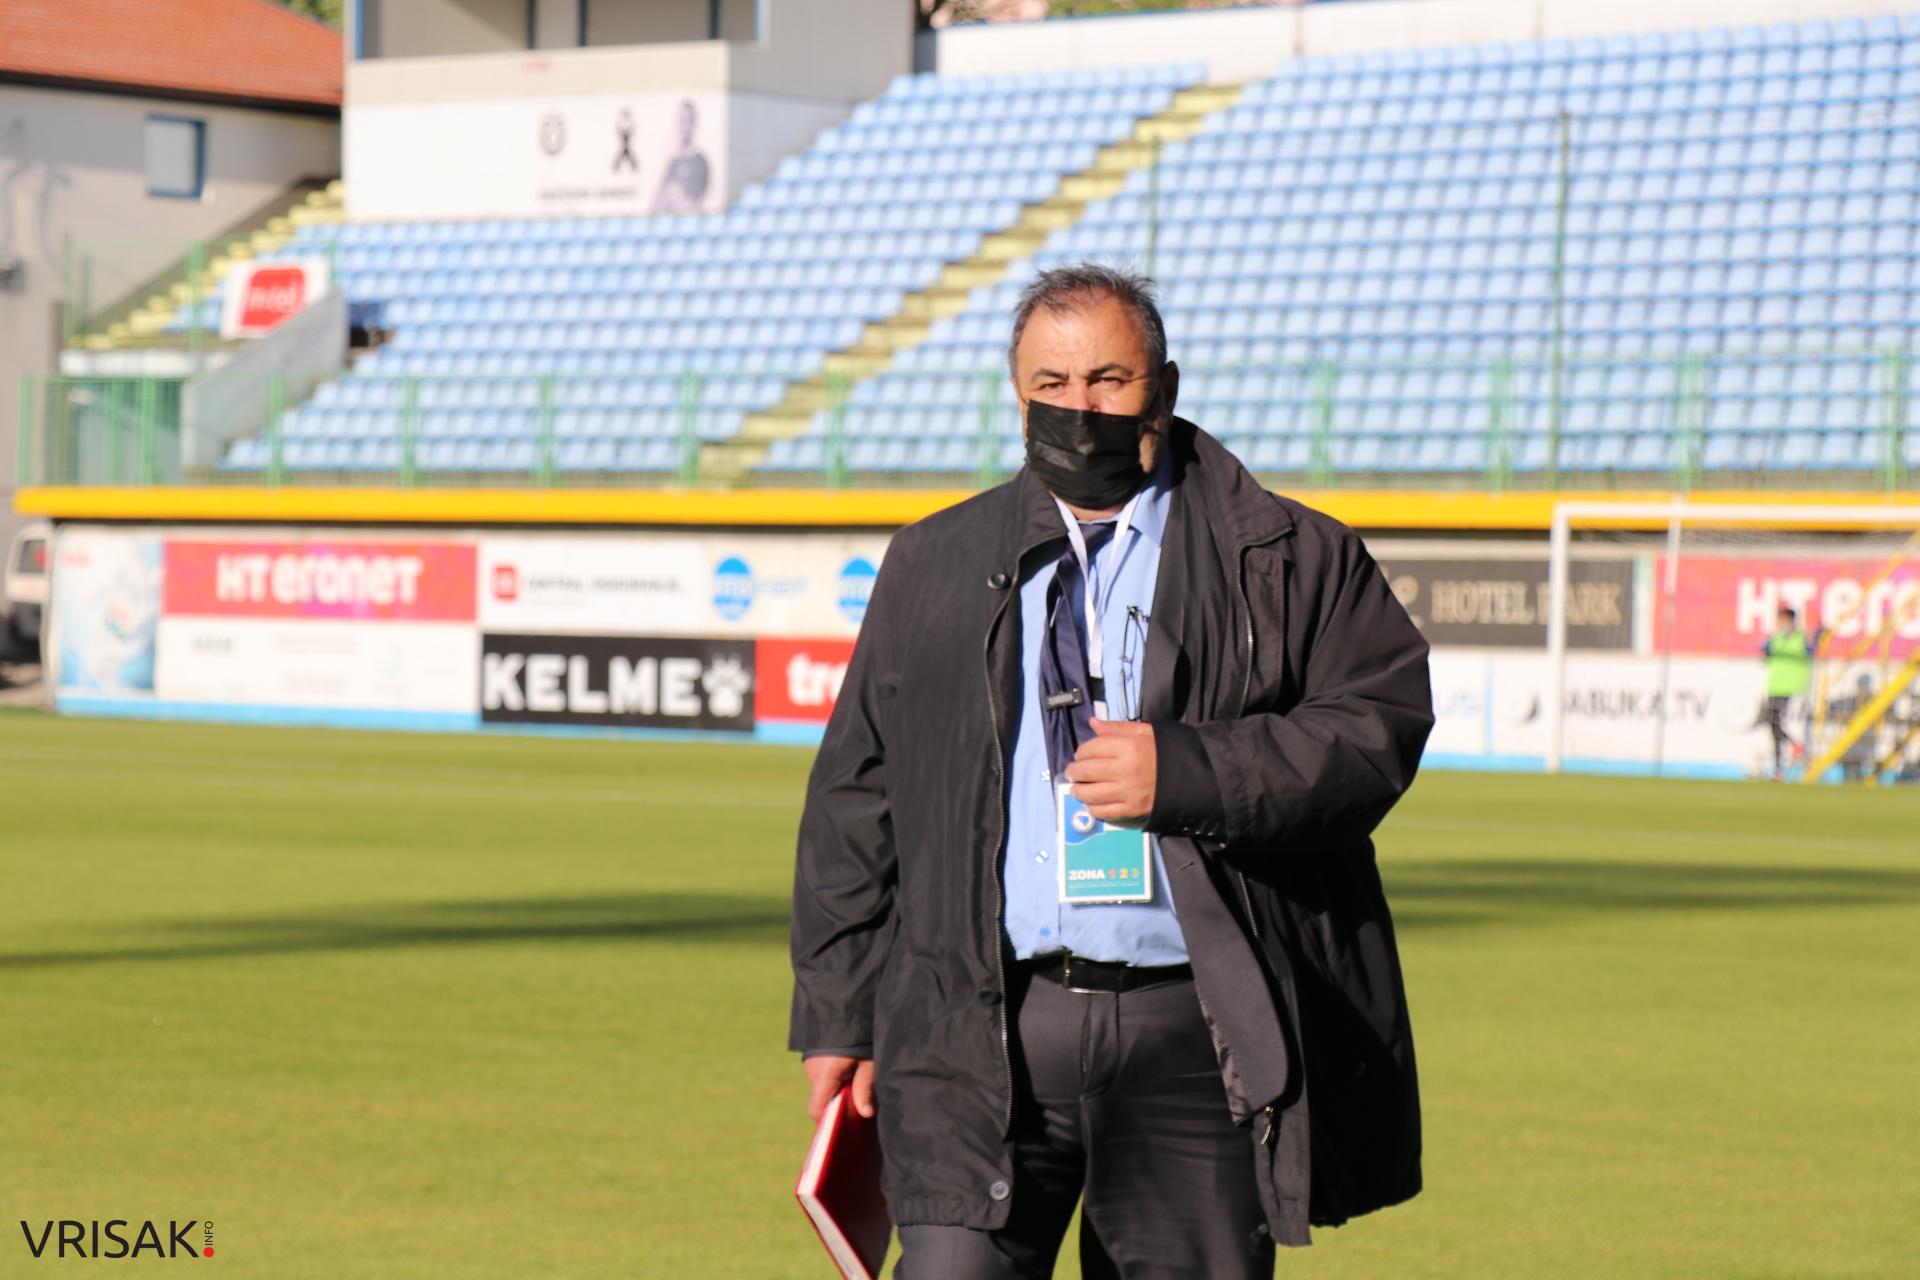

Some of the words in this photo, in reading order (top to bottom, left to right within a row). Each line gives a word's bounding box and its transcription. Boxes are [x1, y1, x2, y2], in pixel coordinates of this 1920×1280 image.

[1431, 579, 1536, 625] HOTEL
[483, 652, 702, 717] KELME
[1068, 869, 1106, 881] ZONA
[1119, 867, 1129, 880] 2
